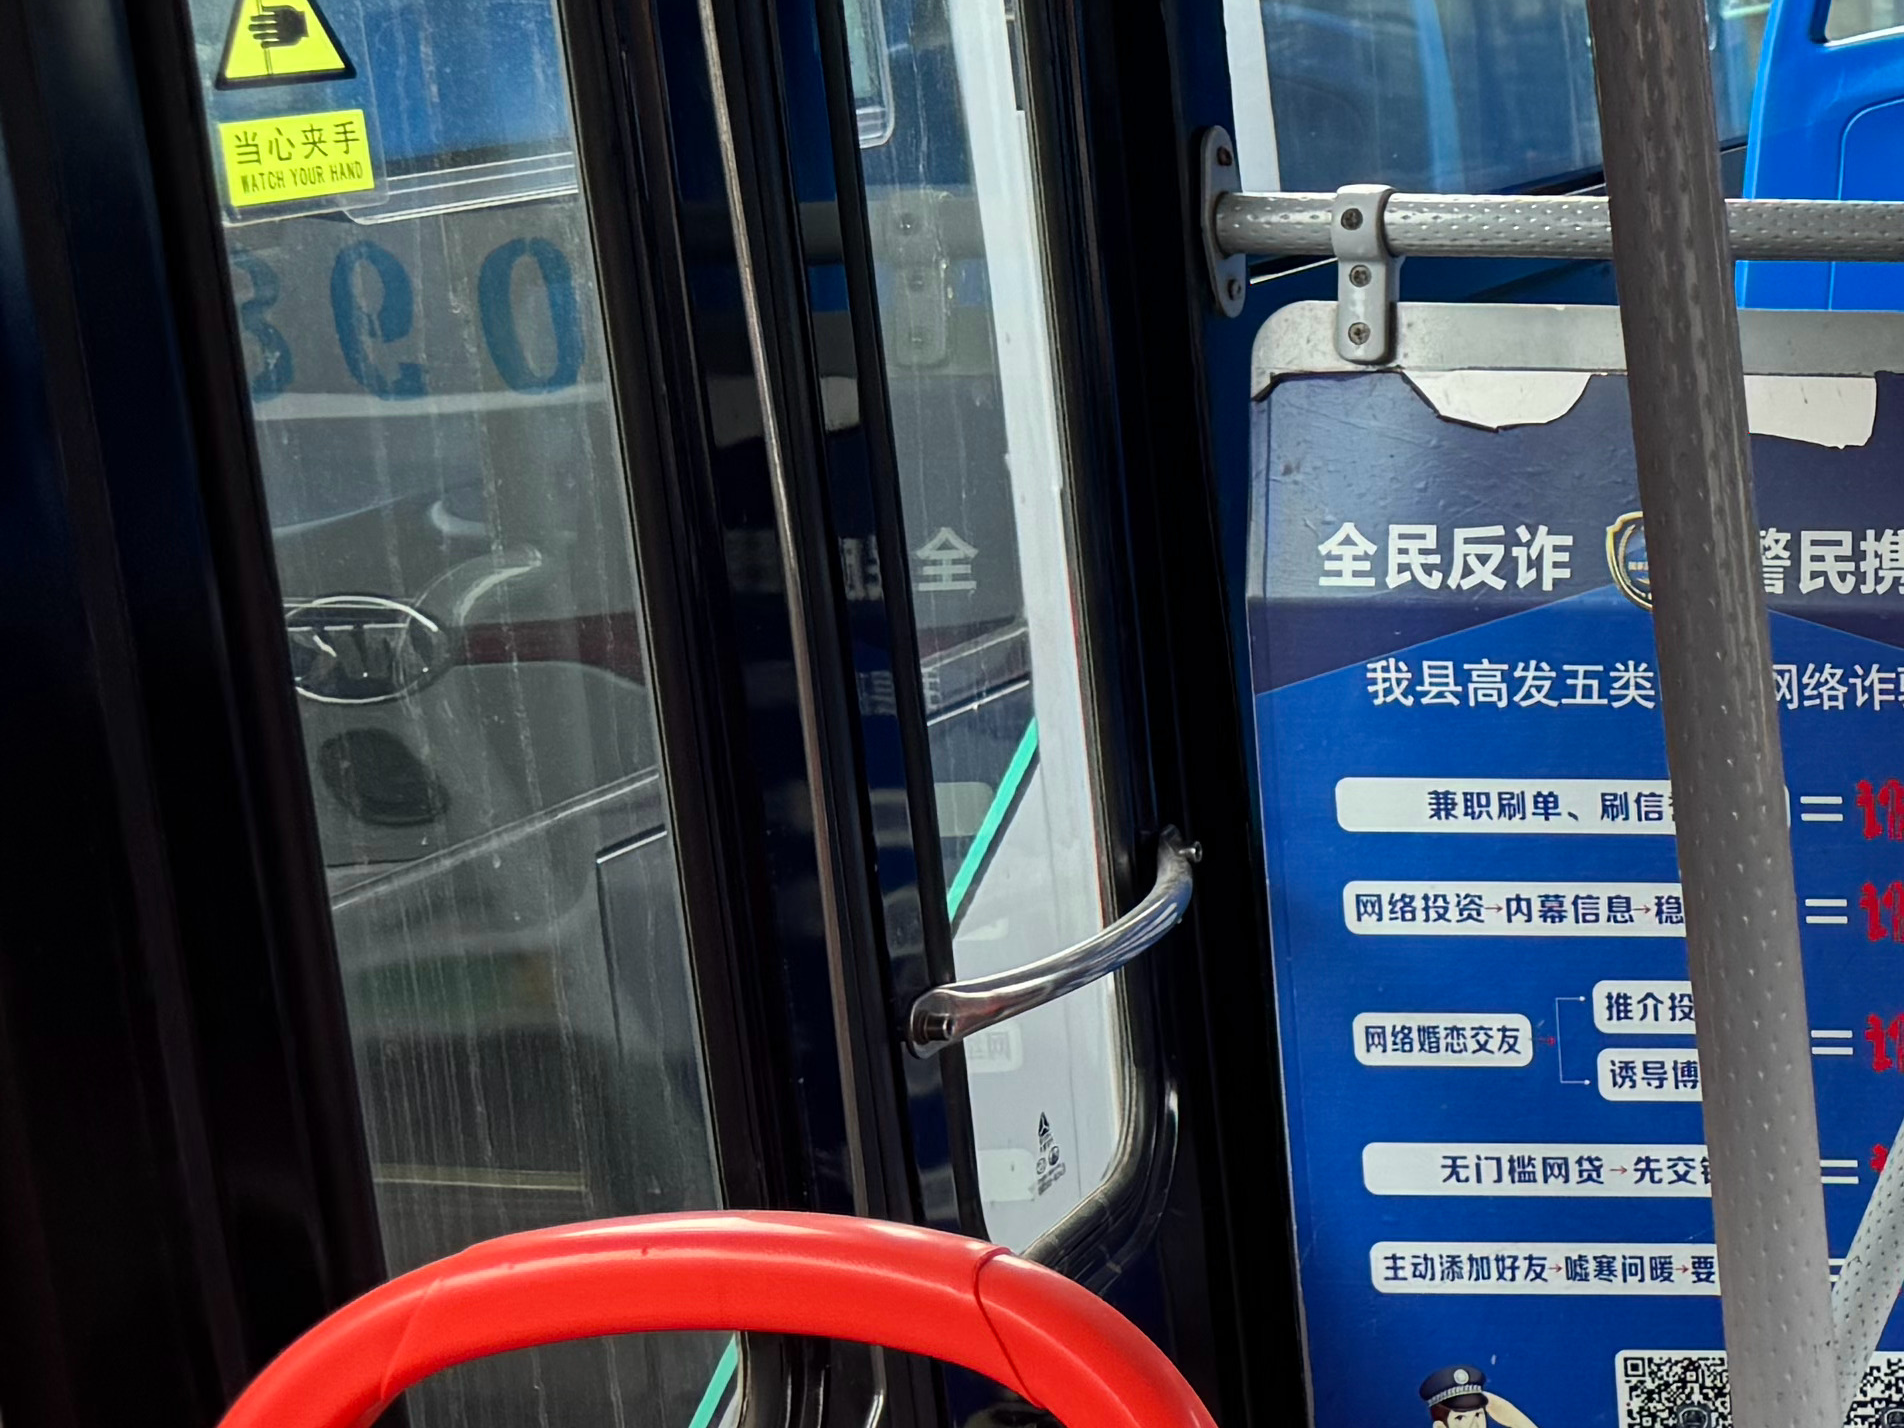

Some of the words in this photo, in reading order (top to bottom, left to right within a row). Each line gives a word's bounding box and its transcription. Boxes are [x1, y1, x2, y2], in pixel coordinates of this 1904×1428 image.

[234, 121, 360, 165] 当心夹手
[241, 170, 286, 194] WATCH
[289, 165, 326, 187] YOUR
[330, 160, 363, 181] HAND
[1317, 521, 1575, 592] 全民反诈
[1427, 789, 1677, 823] 兼职刷单、刷信
[1604, 991, 1696, 1023] 推介投
[1364, 1024, 1523, 1056] 网络婚恋交友
[1609, 1059, 1700, 1091] 诱导博
